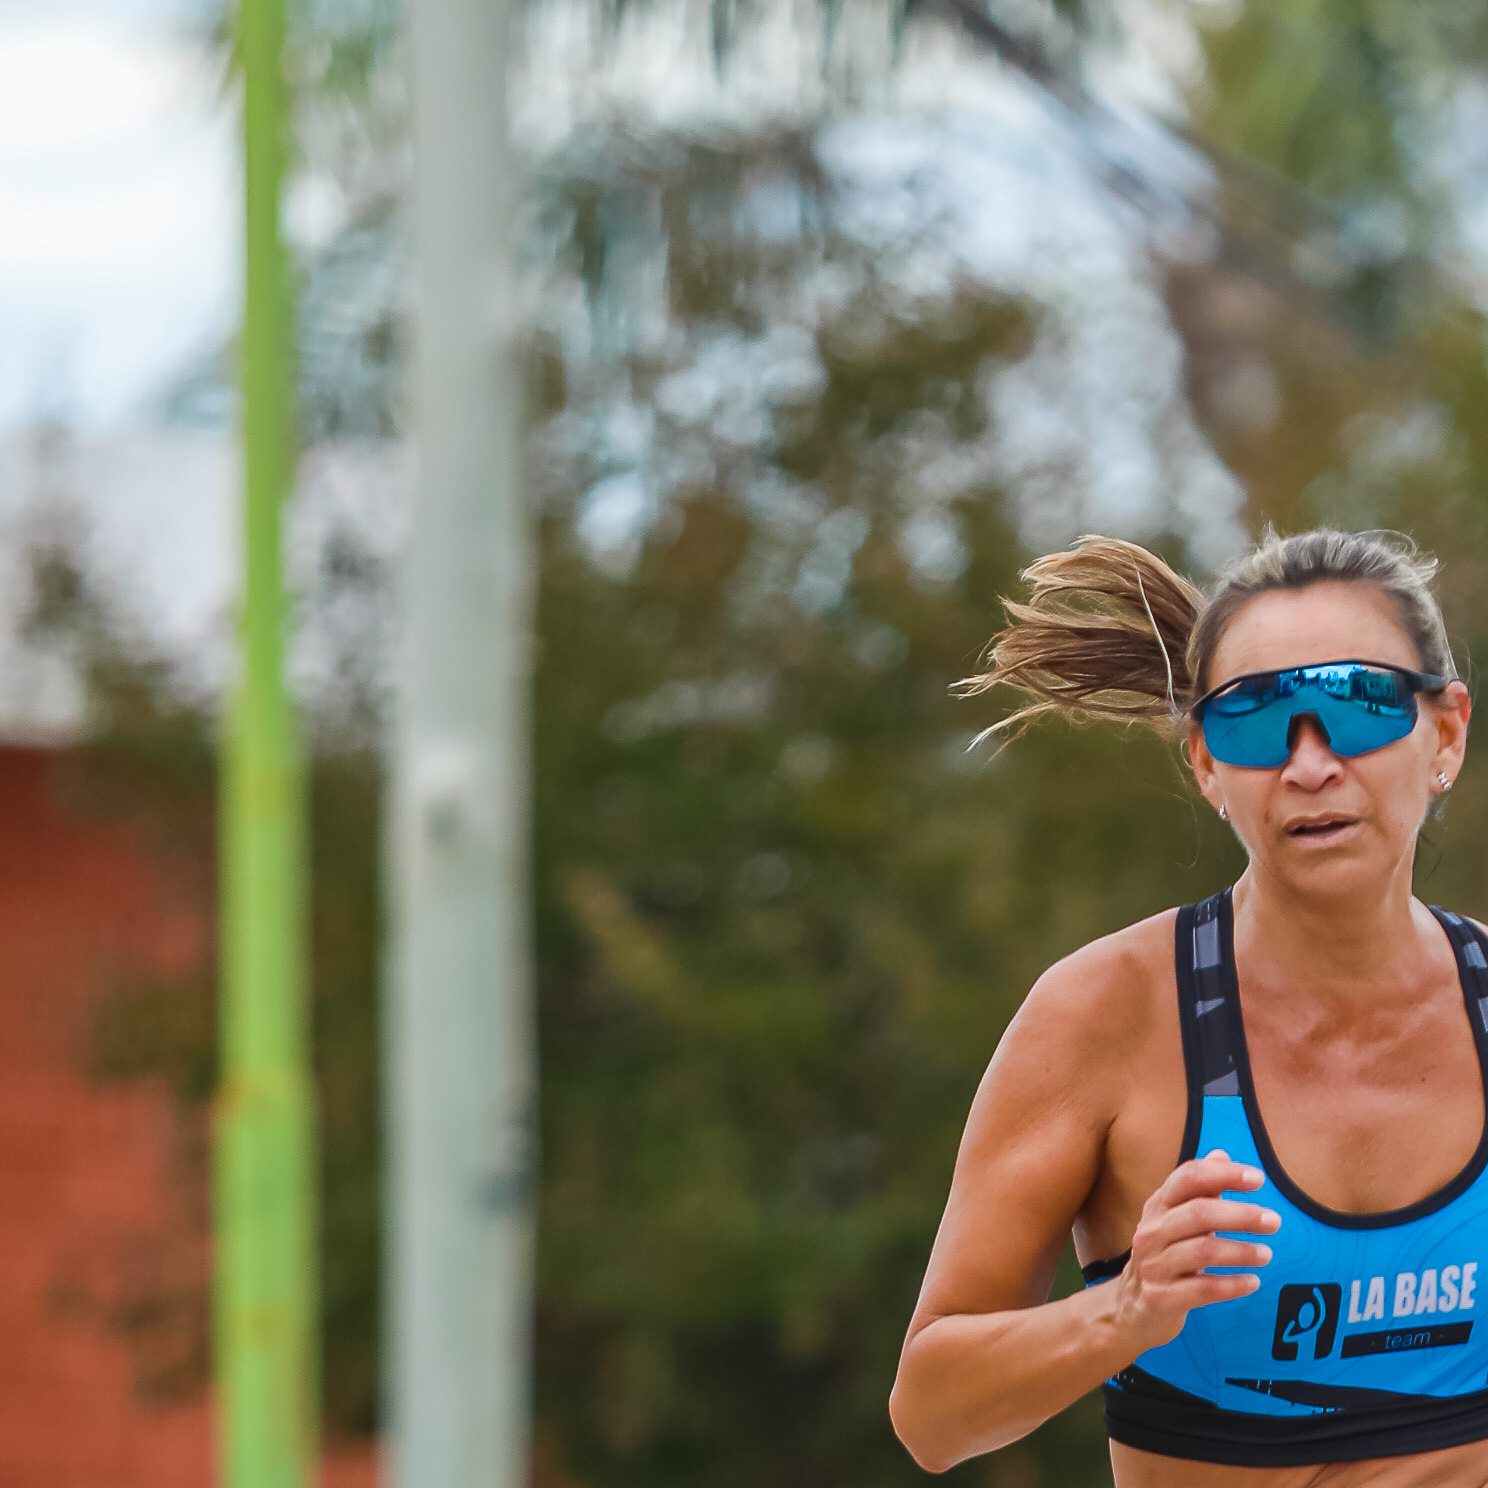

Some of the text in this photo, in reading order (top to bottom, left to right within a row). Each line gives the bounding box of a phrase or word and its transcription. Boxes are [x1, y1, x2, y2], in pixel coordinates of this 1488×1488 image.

[1347, 1261, 1478, 1323] LA BASE
[1385, 1331, 1431, 1350] team
